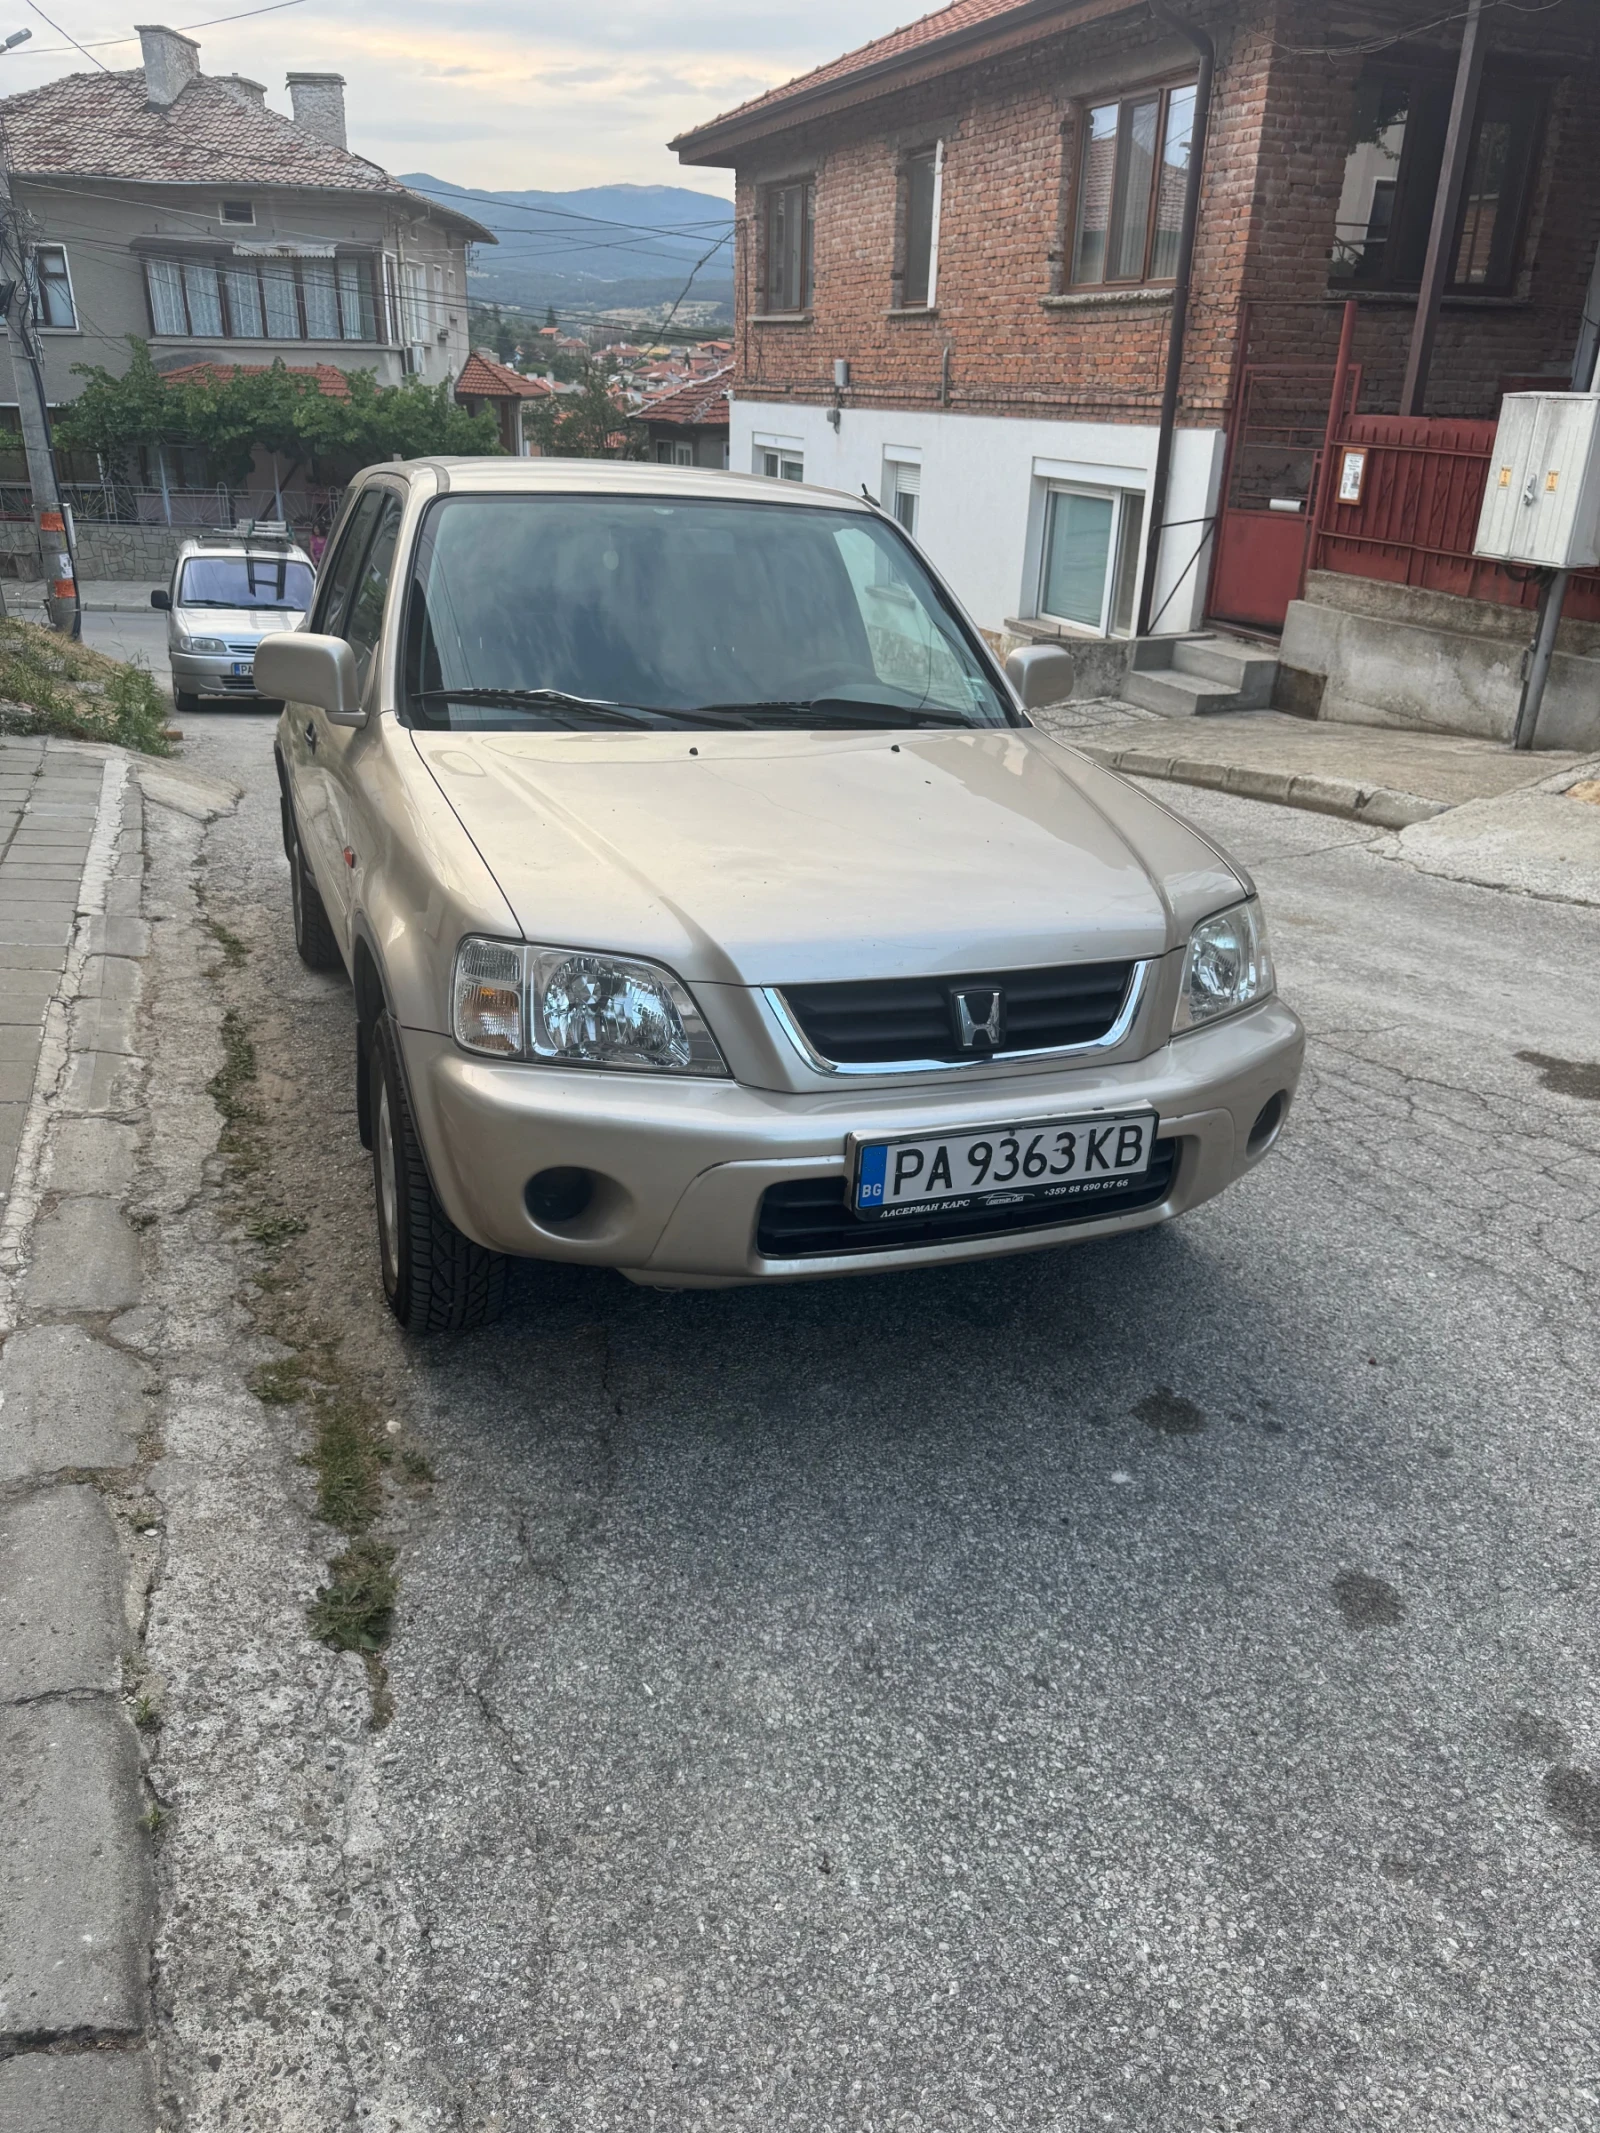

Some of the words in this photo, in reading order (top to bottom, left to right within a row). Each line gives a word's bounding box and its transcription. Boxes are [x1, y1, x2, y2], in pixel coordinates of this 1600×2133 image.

[893, 1145, 953, 1195] PA
[967, 1132, 1076, 1186] 9363
[1085, 1125, 1143, 1171] KB
[861, 1183, 882, 1198] BG
[1044, 1187, 1066, 1196] +359
[1068, 1185, 1081, 1193] 88
[1083, 1183, 1101, 1191] 690
[1103, 1181, 1116, 1189] 67
[1116, 1179, 1129, 1187] 66
[880, 1203, 939, 1218] ЛАСЕРМАН
[941, 1199, 970, 1210] КАРС
